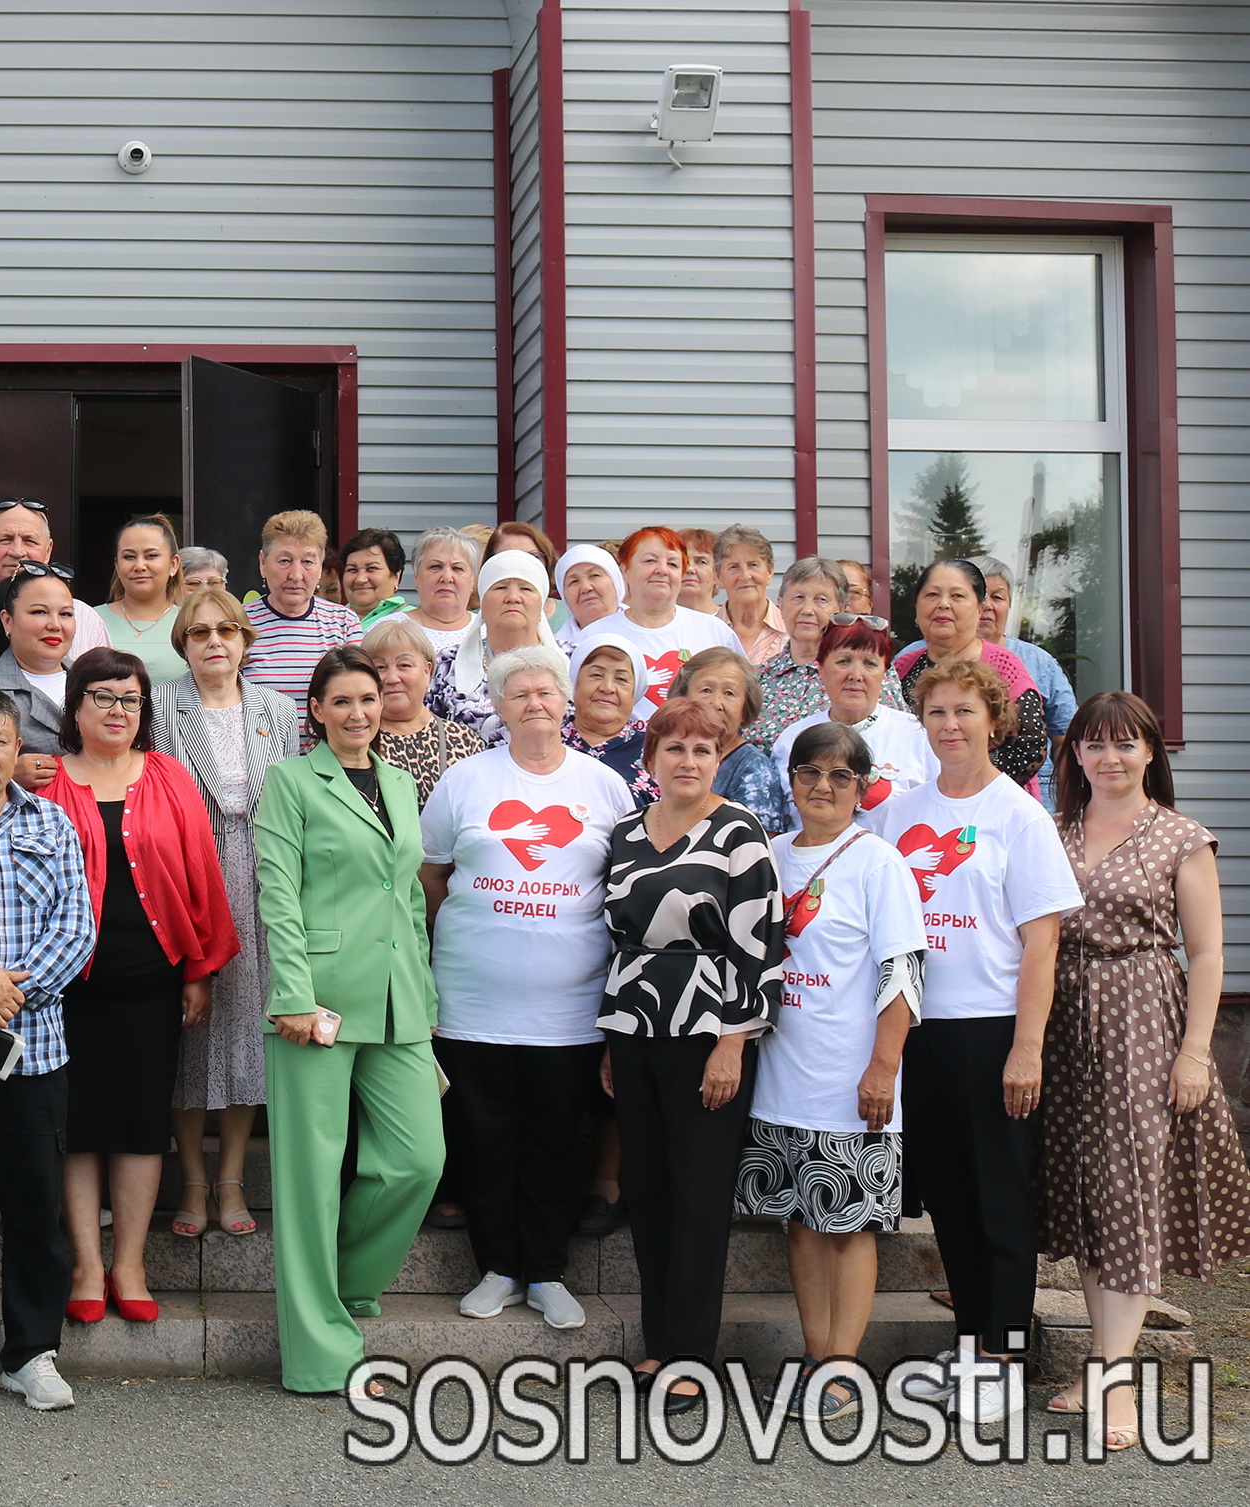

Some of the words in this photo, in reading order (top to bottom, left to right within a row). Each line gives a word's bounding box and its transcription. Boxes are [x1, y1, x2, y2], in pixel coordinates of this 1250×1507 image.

[473, 876, 515, 893] СОЮЗ
[517, 881, 582, 897] ДОБРЫХ
[493, 899, 557, 920] СЕРДЕЦ
[923, 912, 978, 930] ОБРЫХ
[782, 970, 831, 987] ОБРЫХ
